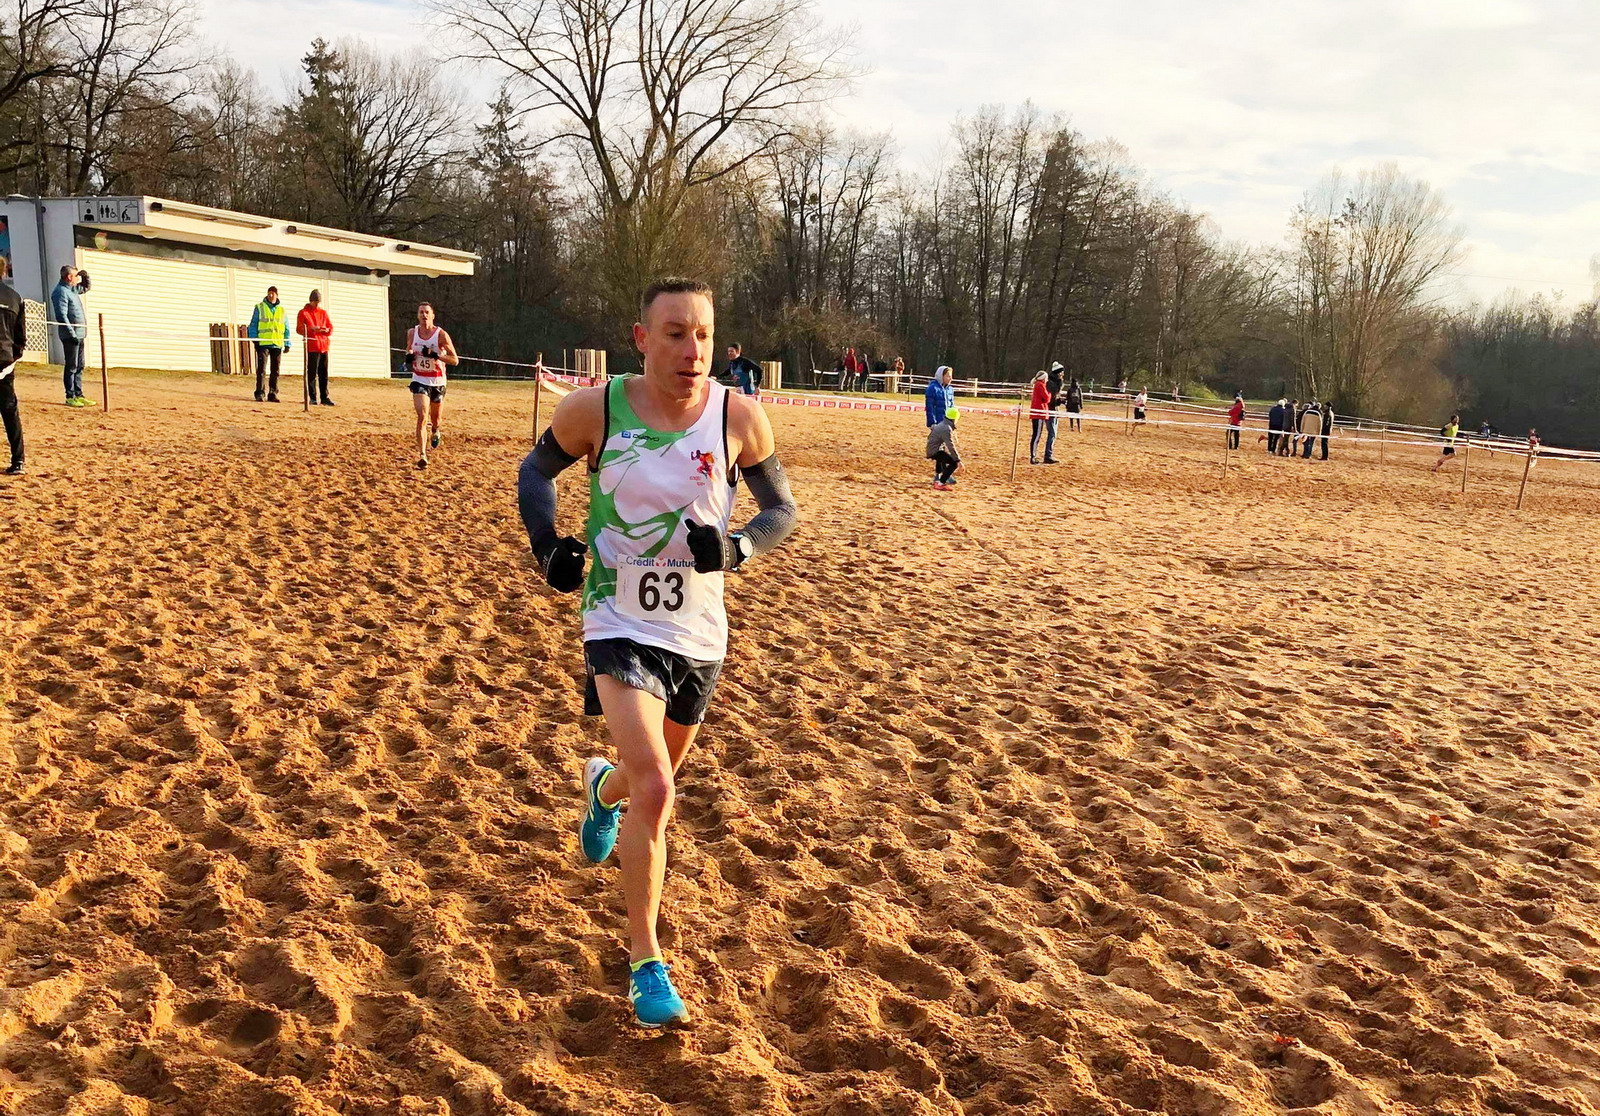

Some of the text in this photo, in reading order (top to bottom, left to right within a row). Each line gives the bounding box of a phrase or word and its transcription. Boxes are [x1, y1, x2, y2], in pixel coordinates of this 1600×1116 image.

[419, 359, 431, 369] 45
[626, 556, 697, 567] Crédit Mutue
[638, 571, 684, 611] 63
